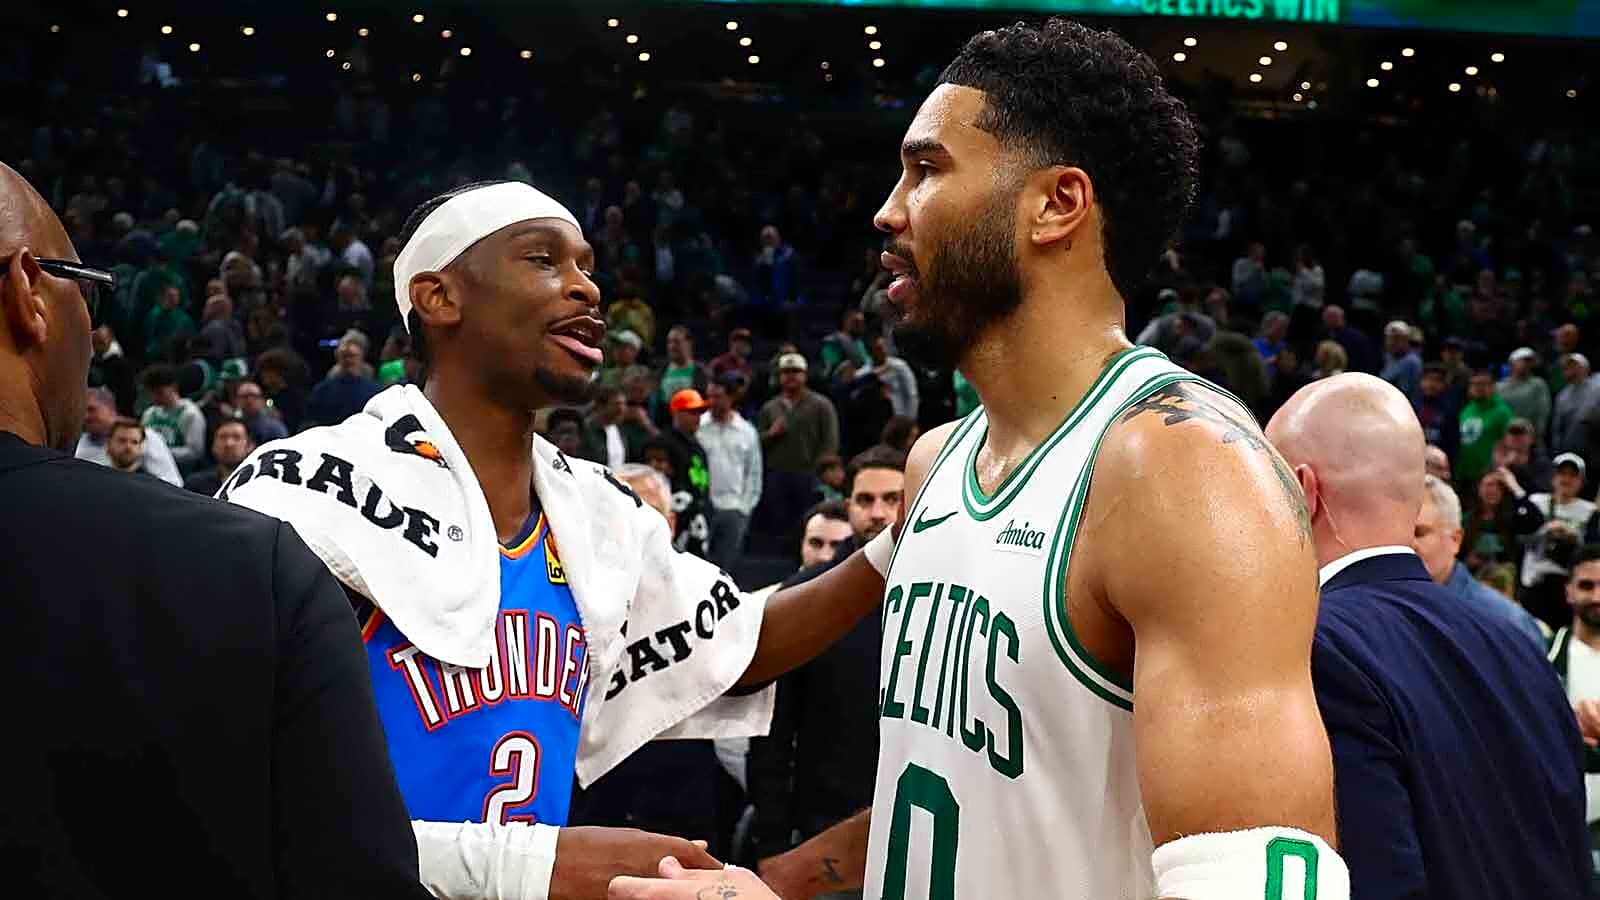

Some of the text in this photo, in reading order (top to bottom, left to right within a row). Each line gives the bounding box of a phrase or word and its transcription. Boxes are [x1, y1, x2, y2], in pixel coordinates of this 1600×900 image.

[1141, 0, 1339, 23] CELTICS WIN
[995, 518, 1046, 550] Amica
[880, 581, 1024, 780] CELTICS
[481, 730, 542, 826] 2
[881, 761, 961, 900] 0
[1264, 836, 1319, 900] 0
